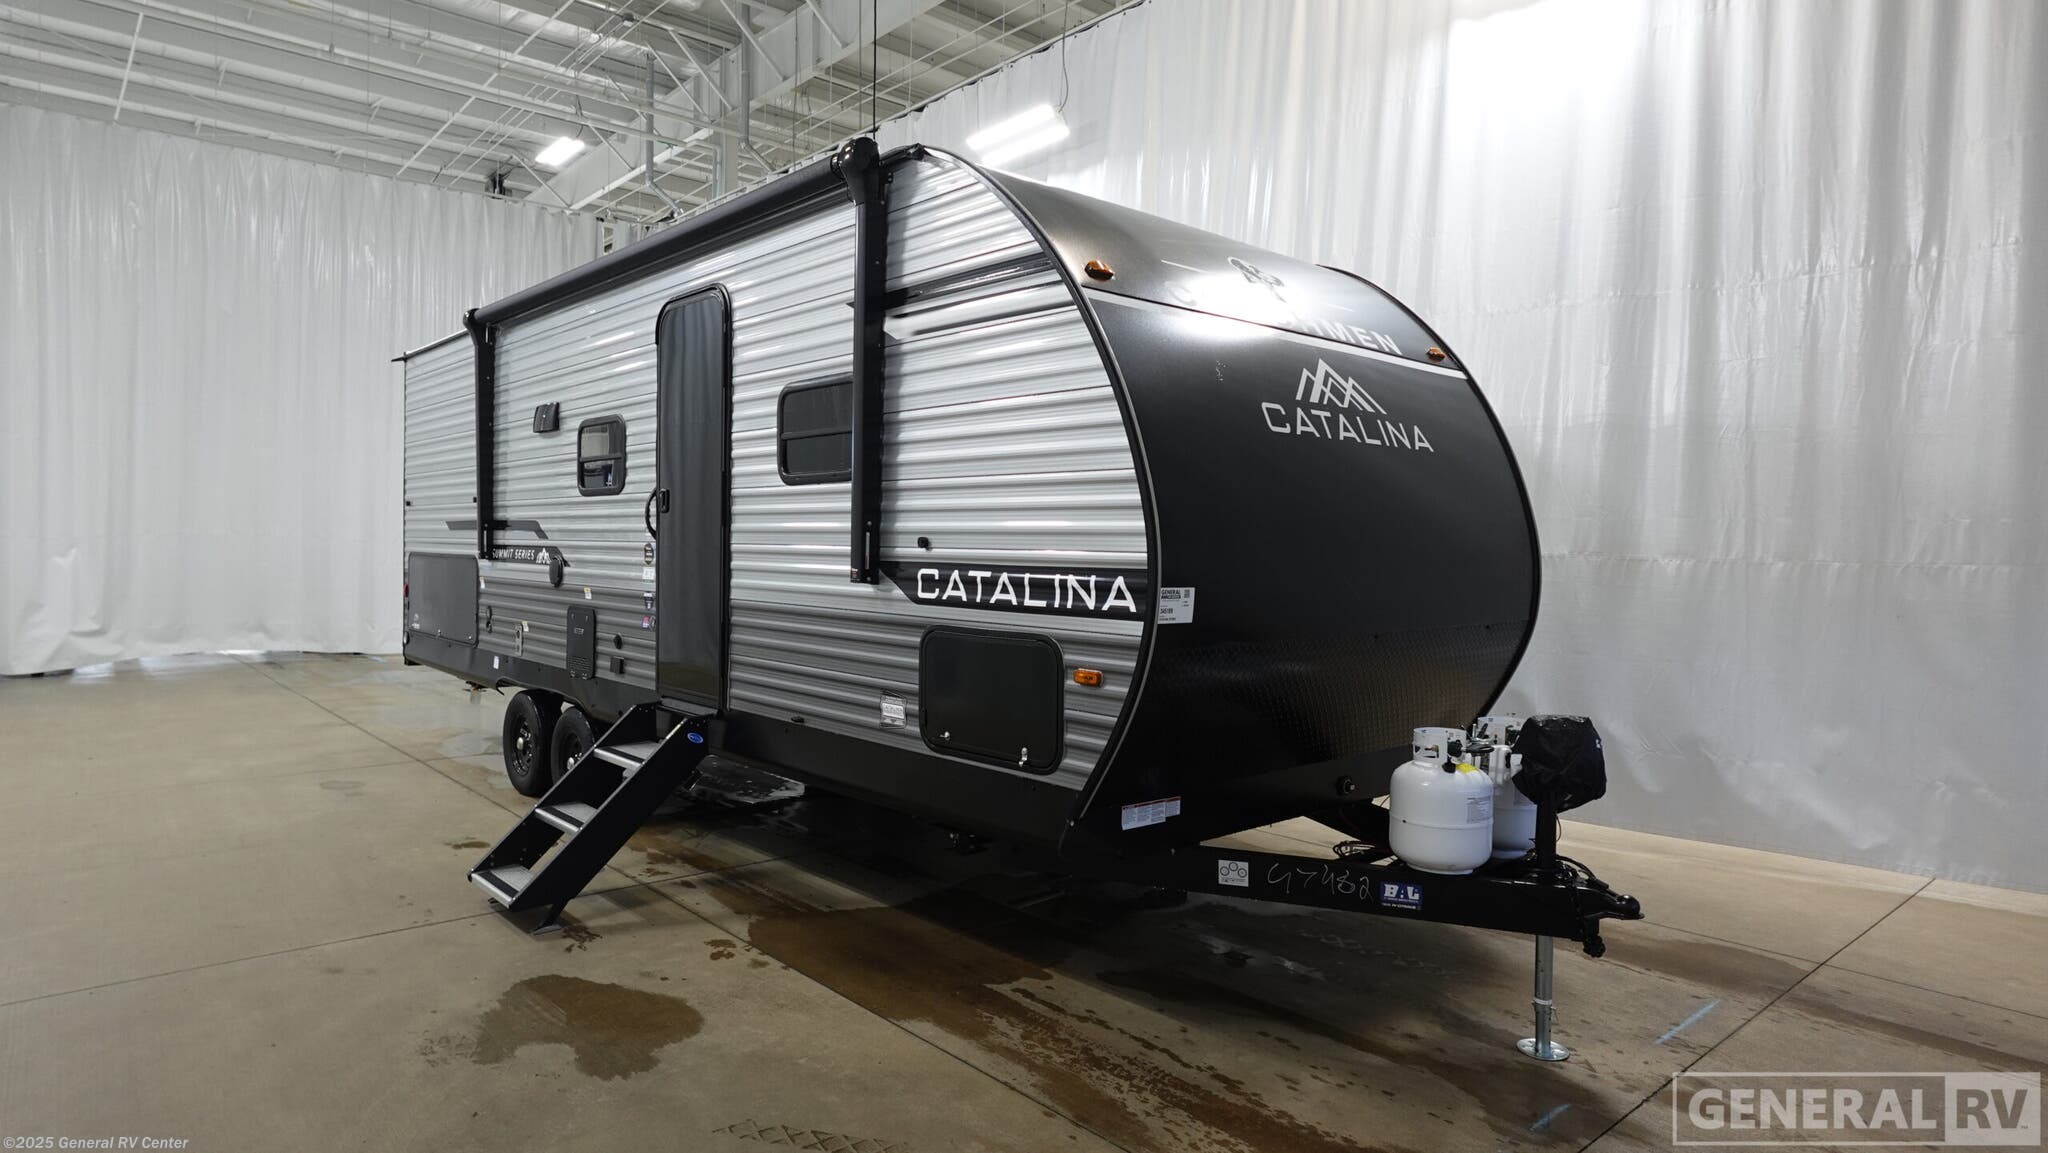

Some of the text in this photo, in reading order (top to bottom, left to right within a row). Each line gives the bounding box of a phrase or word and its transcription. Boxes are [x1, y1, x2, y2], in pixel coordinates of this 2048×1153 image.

[1261, 402, 1434, 453] CATALINA
[492, 547, 535, 561] SUMMIT SERIES
[917, 568, 1137, 613] CATALINA
